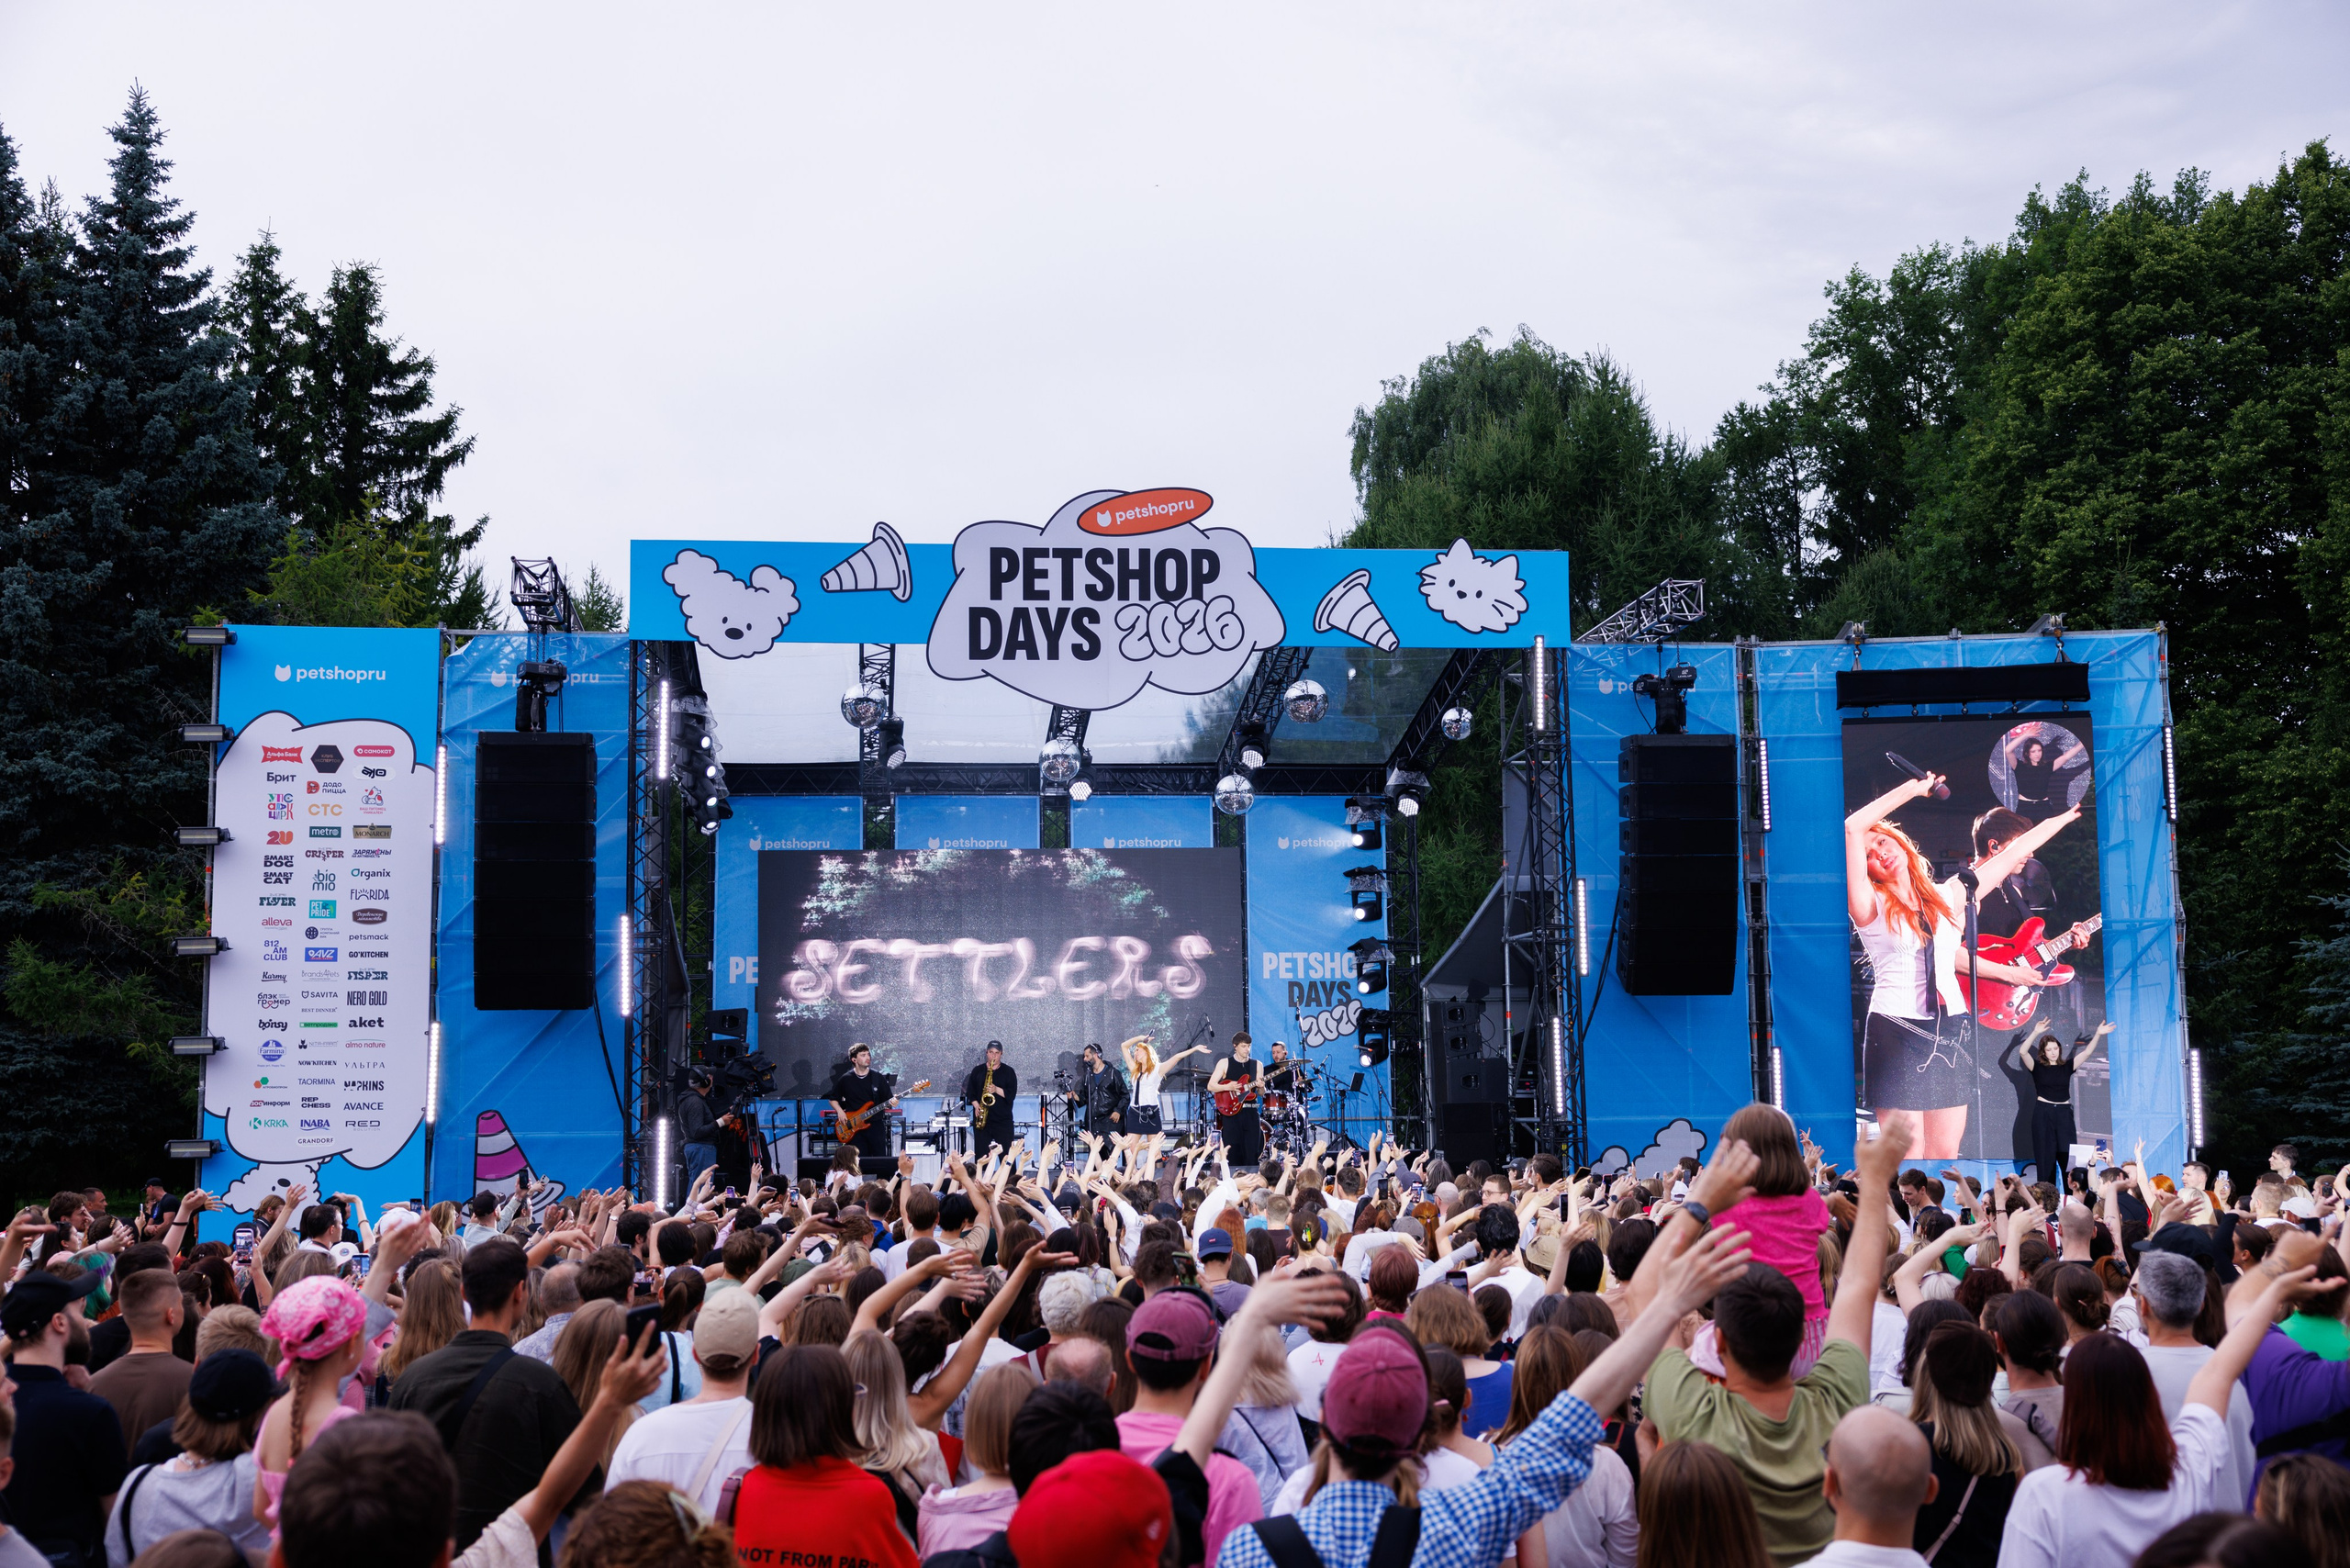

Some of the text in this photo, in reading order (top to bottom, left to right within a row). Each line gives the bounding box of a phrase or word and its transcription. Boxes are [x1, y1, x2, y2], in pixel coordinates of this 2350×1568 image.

[1115, 499, 1194, 524] petshopru
[990, 547, 1221, 602] PETSHOP
[968, 595, 1245, 662] DAYS 2026
[297, 666, 386, 684] petshopru
[266, 772, 297, 784] Брит
[311, 827, 340, 835] metro
[765, 838, 830, 850] petshopru
[944, 837, 1008, 848] petshopru
[1118, 836, 1181, 848] petshopru
[305, 850, 344, 861] CRISPER
[351, 868, 391, 880] Organix
[259, 897, 296, 906] FLYER
[311, 909, 330, 917] PRIDE
[262, 917, 292, 926] alleva
[780, 935, 1212, 1003] SETTLERS
[1262, 951, 1358, 980] PETSHO
[261, 972, 287, 983] Karmy
[347, 991, 387, 1005] NERO GOLD
[1288, 980, 1352, 1008] DAYS
[349, 1017, 384, 1027] aket
[264, 1119, 288, 1127] KRKA
[300, 1119, 330, 1127] INABA
[737, 1547, 774, 1563] NOT
[780, 1551, 833, 1568] FROM
